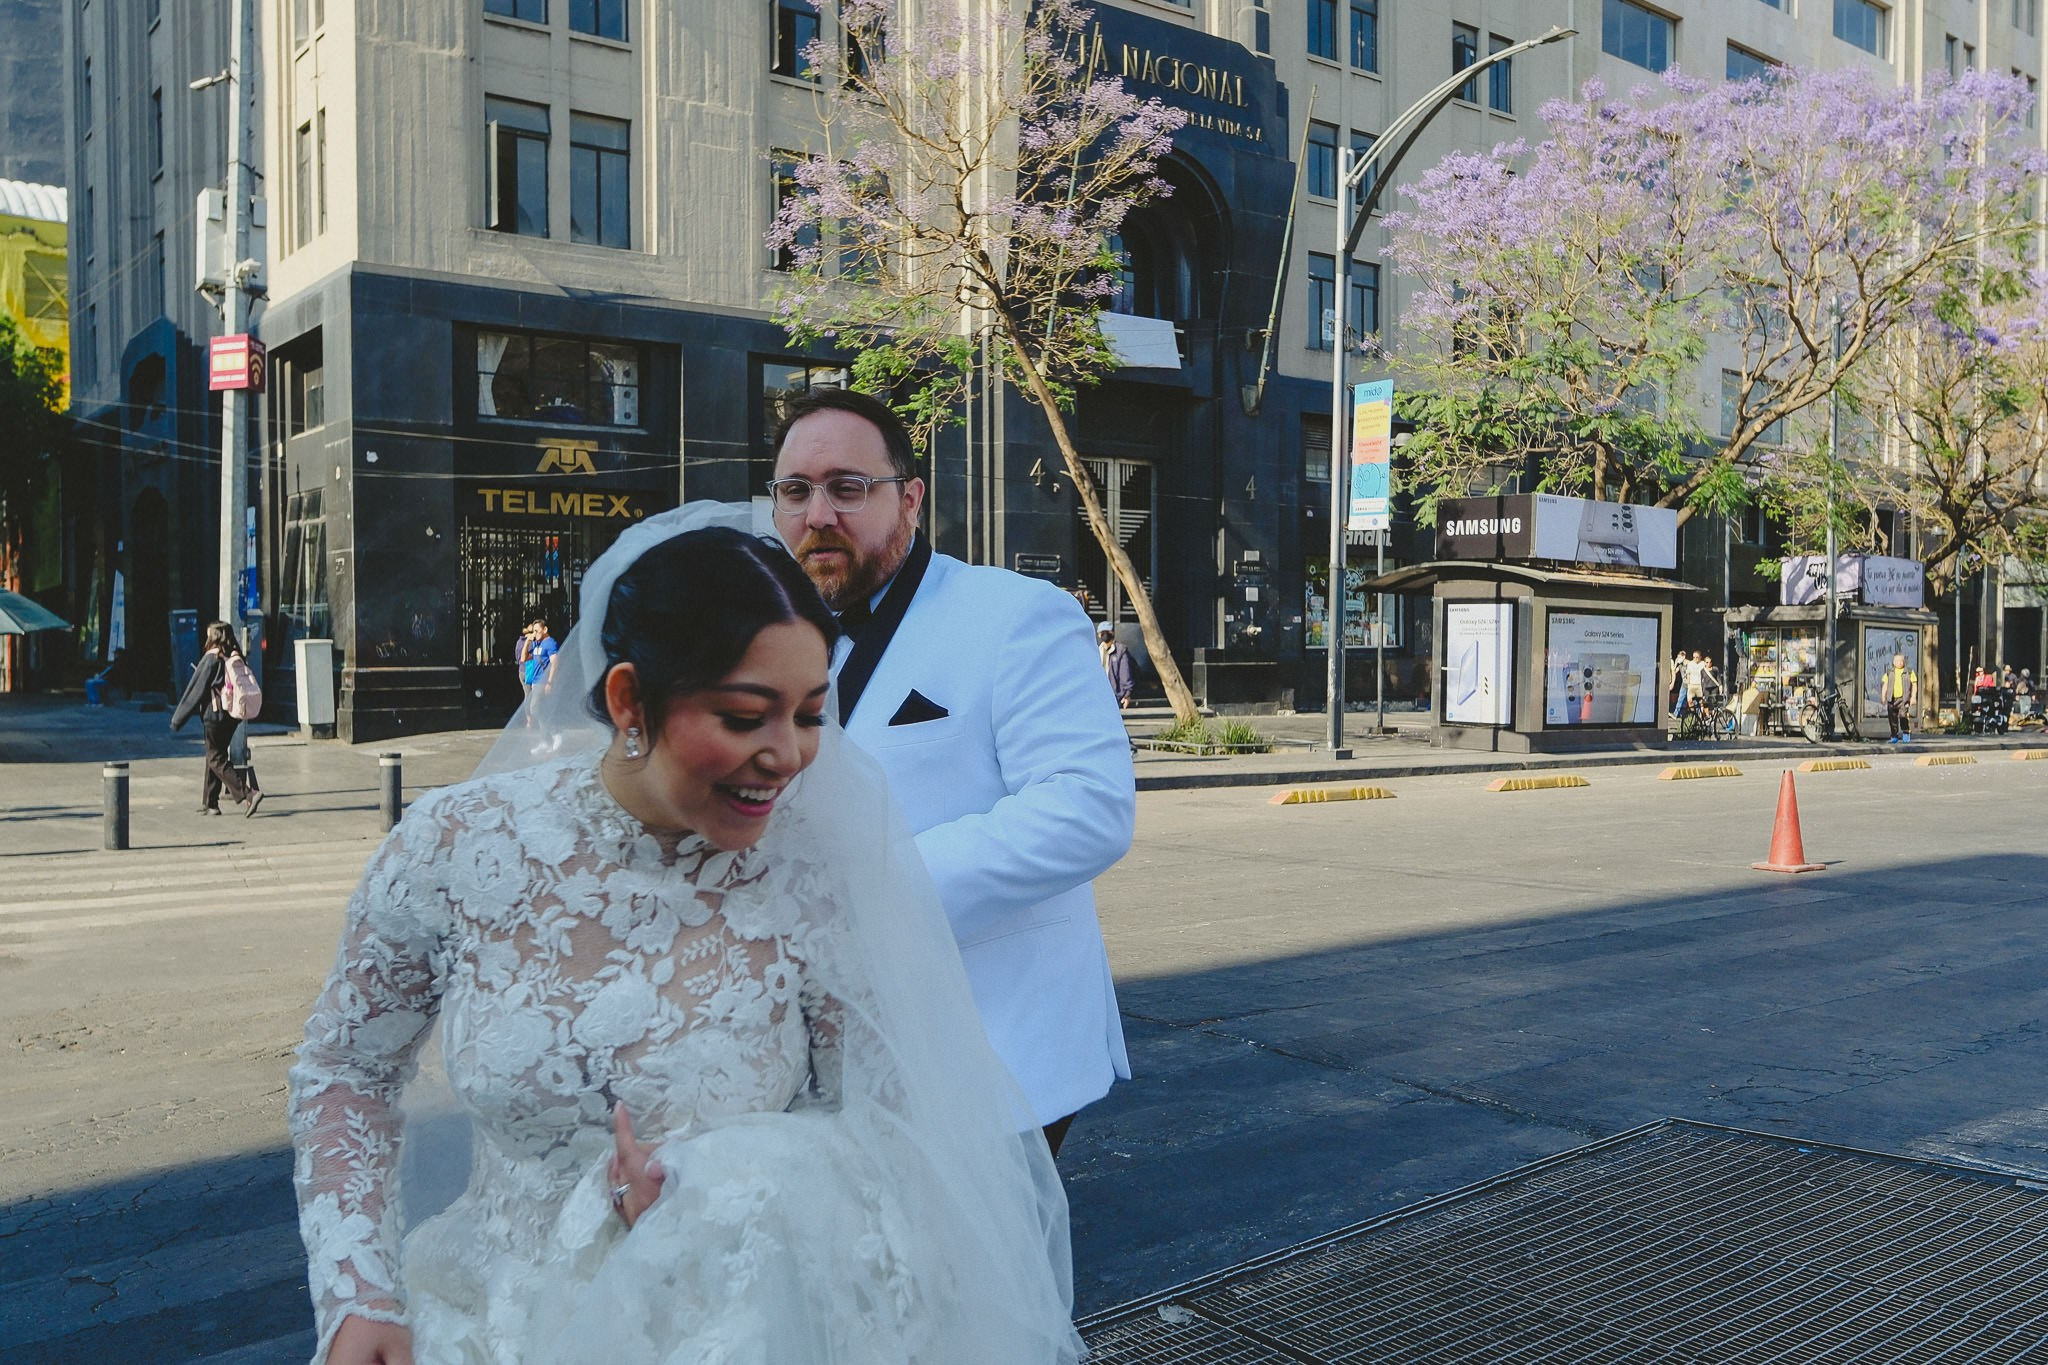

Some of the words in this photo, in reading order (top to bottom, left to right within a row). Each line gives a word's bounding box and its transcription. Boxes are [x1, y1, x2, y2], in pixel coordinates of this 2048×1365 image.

[1122, 43, 1249, 108] NACIONAL
[1216, 118, 1242, 137] VIDA
[1029, 457, 1046, 486] 4
[1245, 474, 1257, 499] 4
[477, 489, 632, 518] TELMEX
[1446, 517, 1521, 537] SAMSUNG
[1551, 617, 1576, 625] SAMSUNG
[1584, 630, 1601, 639] Galaxy
[1601, 630, 1610, 638] S24
